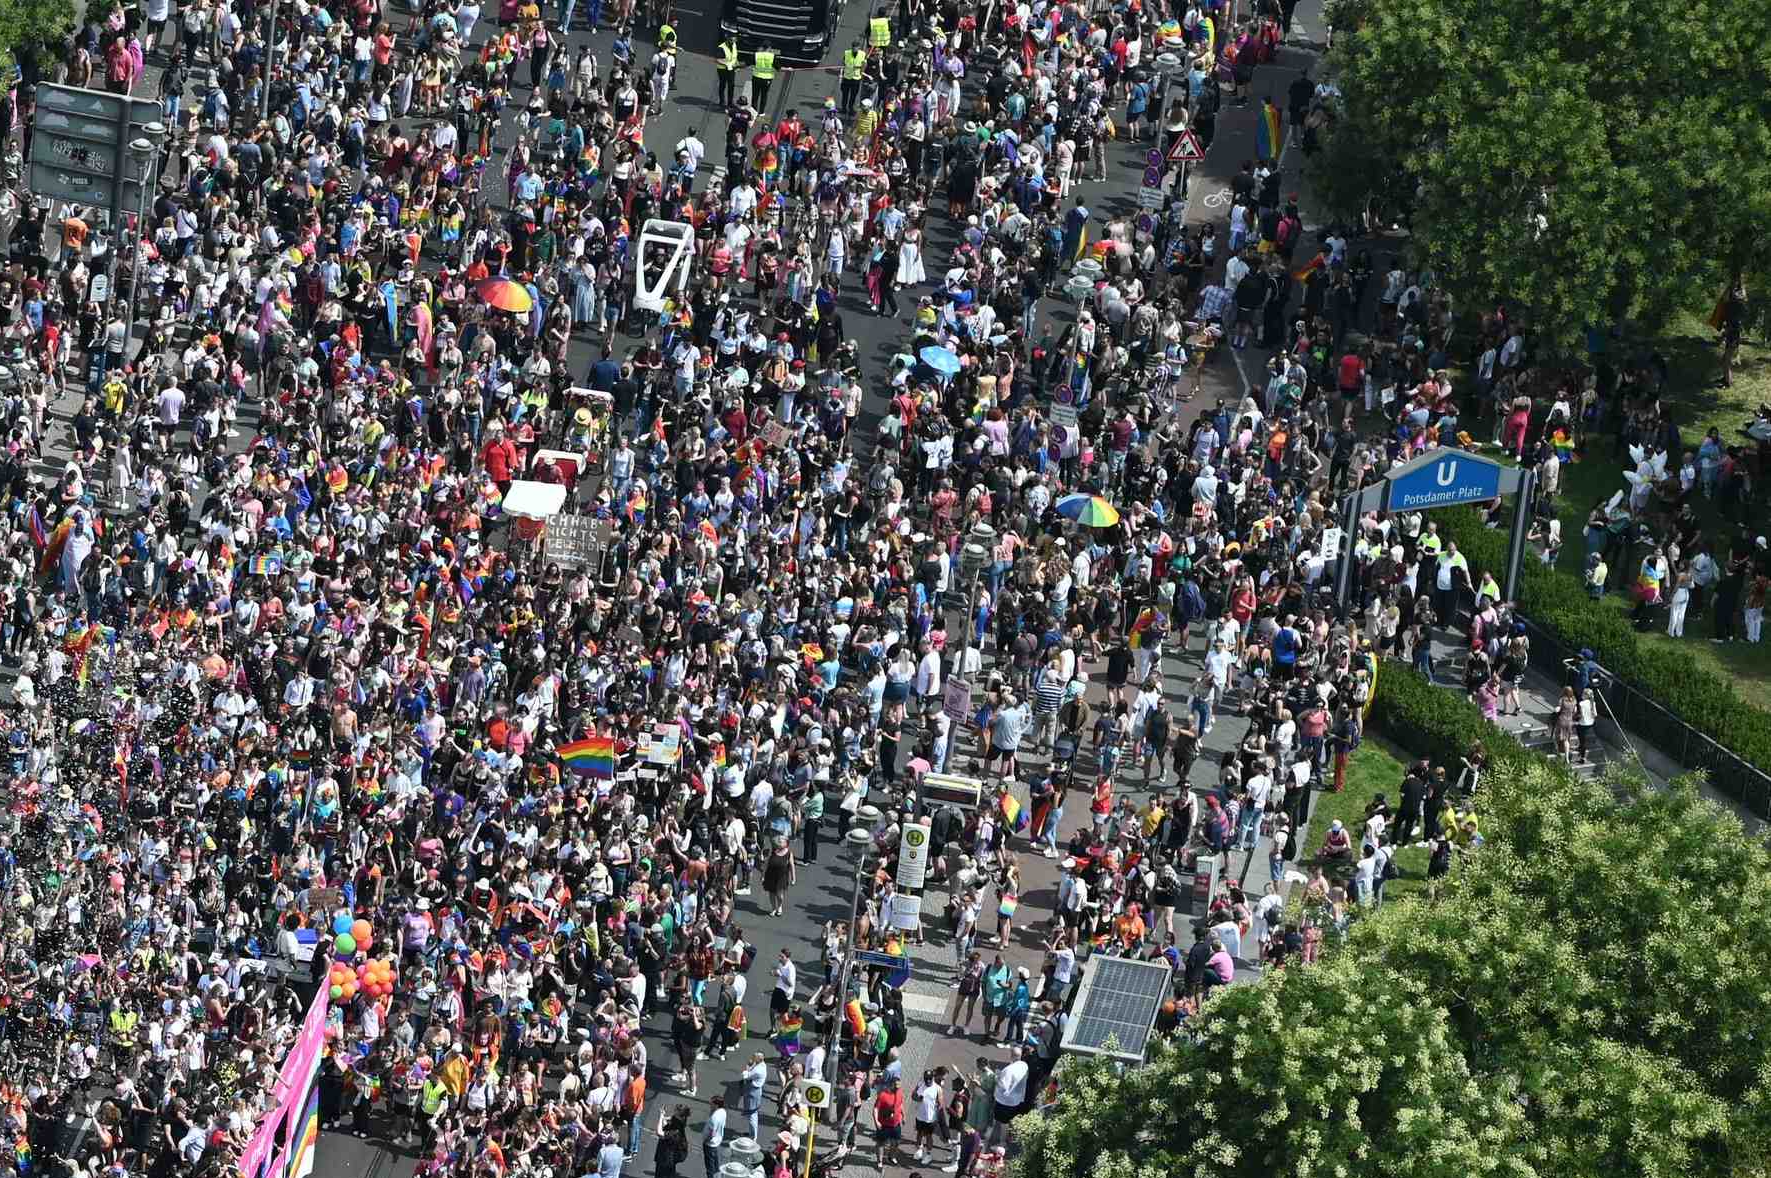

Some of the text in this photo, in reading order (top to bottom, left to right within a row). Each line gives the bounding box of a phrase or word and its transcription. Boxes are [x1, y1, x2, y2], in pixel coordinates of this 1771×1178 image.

[1437, 461, 1457, 486] U
[1403, 487, 1483, 505] Potsdamer Platz
